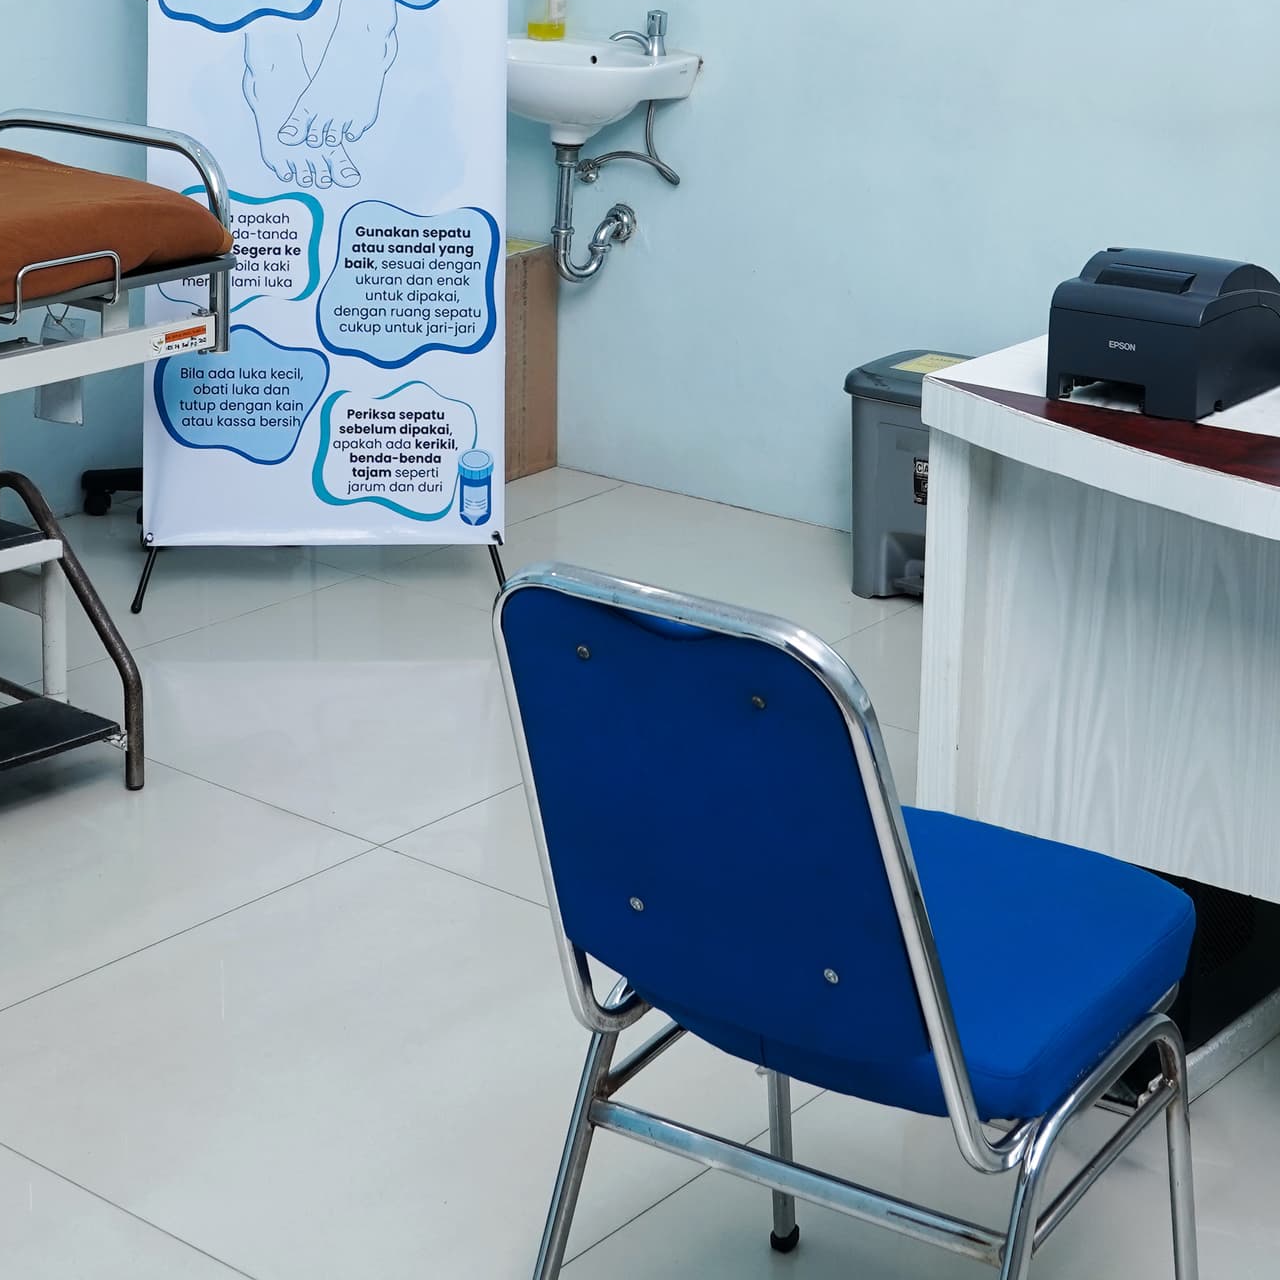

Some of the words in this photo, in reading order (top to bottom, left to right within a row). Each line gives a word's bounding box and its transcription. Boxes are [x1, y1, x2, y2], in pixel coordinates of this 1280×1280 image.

[238, 213, 289, 227] apakah
[233, 228, 298, 241] da-tanda
[356, 226, 419, 237] Gunakan
[423, 228, 470, 241] sepatu
[233, 245, 281, 258] Segera
[285, 245, 301, 256] ke
[352, 242, 384, 253] atau
[388, 243, 435, 253] sandal
[439, 245, 473, 257] yang
[235, 260, 260, 272] bila
[264, 260, 289, 271] kaki
[345, 257, 377, 270] baik,
[381, 258, 424, 269] sesuai
[429, 259, 481, 273] dengan
[356, 274, 402, 285] ukuran
[407, 274, 432, 285] dan
[437, 275, 470, 286] enak
[366, 290, 403, 301] untuk
[407, 290, 459, 304] dipakai,
[334, 305, 386, 320] dengan
[391, 308, 430, 320] ruang
[435, 308, 481, 320] sepatu
[339, 321, 381, 335] cukup
[385, 322, 423, 333] untuk
[426, 322, 475, 336] jari-jari
[1108, 340, 1136, 351] EPSON
[181, 368, 204, 379] Bila
[208, 368, 235, 379] ada
[239, 368, 266, 379] luka
[271, 368, 303, 381] kecil,
[193, 383, 228, 395] obati
[232, 384, 259, 395] luka
[264, 384, 289, 395] dan
[180, 400, 216, 414] tutup
[220, 400, 271, 414] dengan
[276, 400, 303, 411] kain
[182, 416, 213, 426] atau
[217, 415, 255, 427] kassa
[259, 416, 301, 428] bersih
[347, 408, 395, 419] Periksa
[399, 410, 444, 423] sepatu
[339, 424, 396, 434] sebelum
[400, 424, 452, 437] dipakai,
[333, 438, 382, 451] apakah
[386, 439, 411, 449] ada
[416, 439, 458, 450] kerikil,
[350, 453, 441, 463] benda-benda
[352, 466, 391, 480] tajam
[395, 467, 438, 480] seperti
[347, 483, 385, 495] jarum
[389, 482, 414, 492] dan
[418, 482, 442, 492] duri
